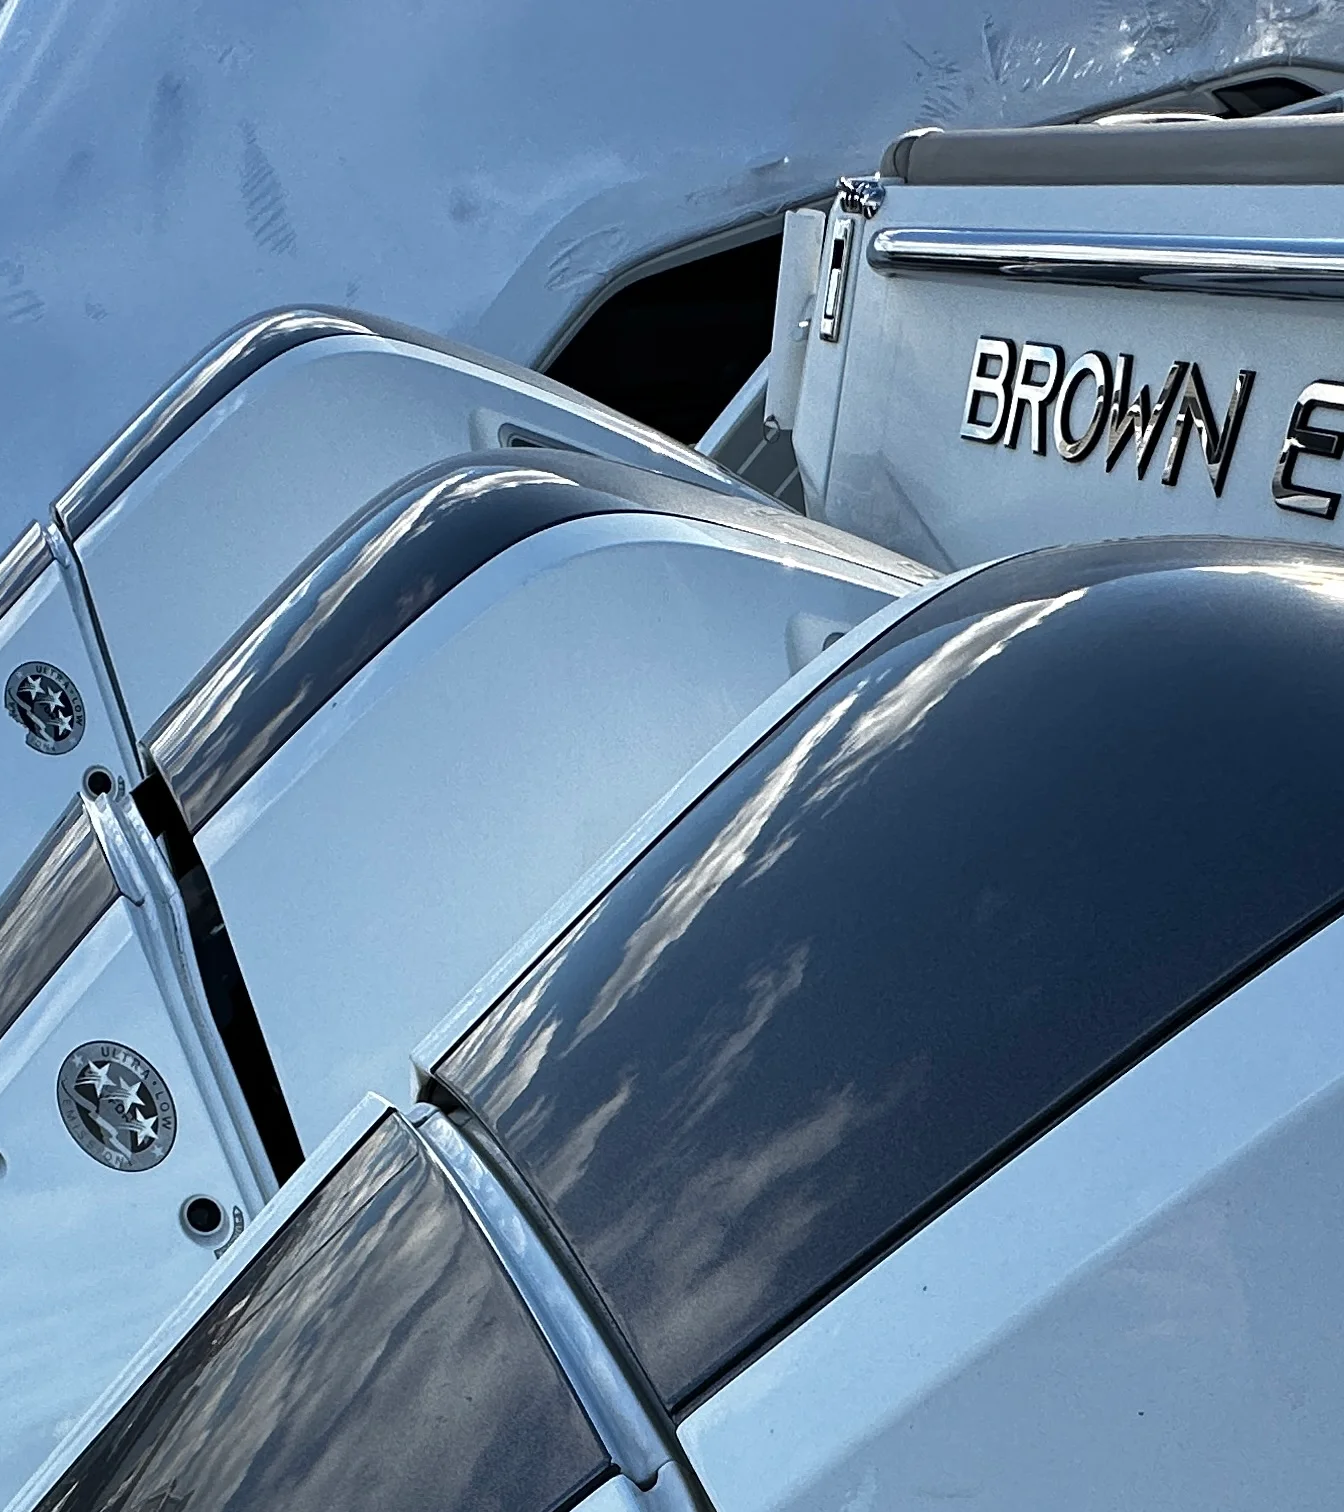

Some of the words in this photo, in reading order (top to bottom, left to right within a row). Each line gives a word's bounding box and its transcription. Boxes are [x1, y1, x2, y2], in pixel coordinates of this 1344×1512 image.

[959, 335, 1256, 498] BROWN
[35, 665, 70, 690] ULTRA
[72, 697, 83, 726] LOW
[100, 1046, 150, 1080] ULTRA
[155, 1090, 172, 1130] LOW
